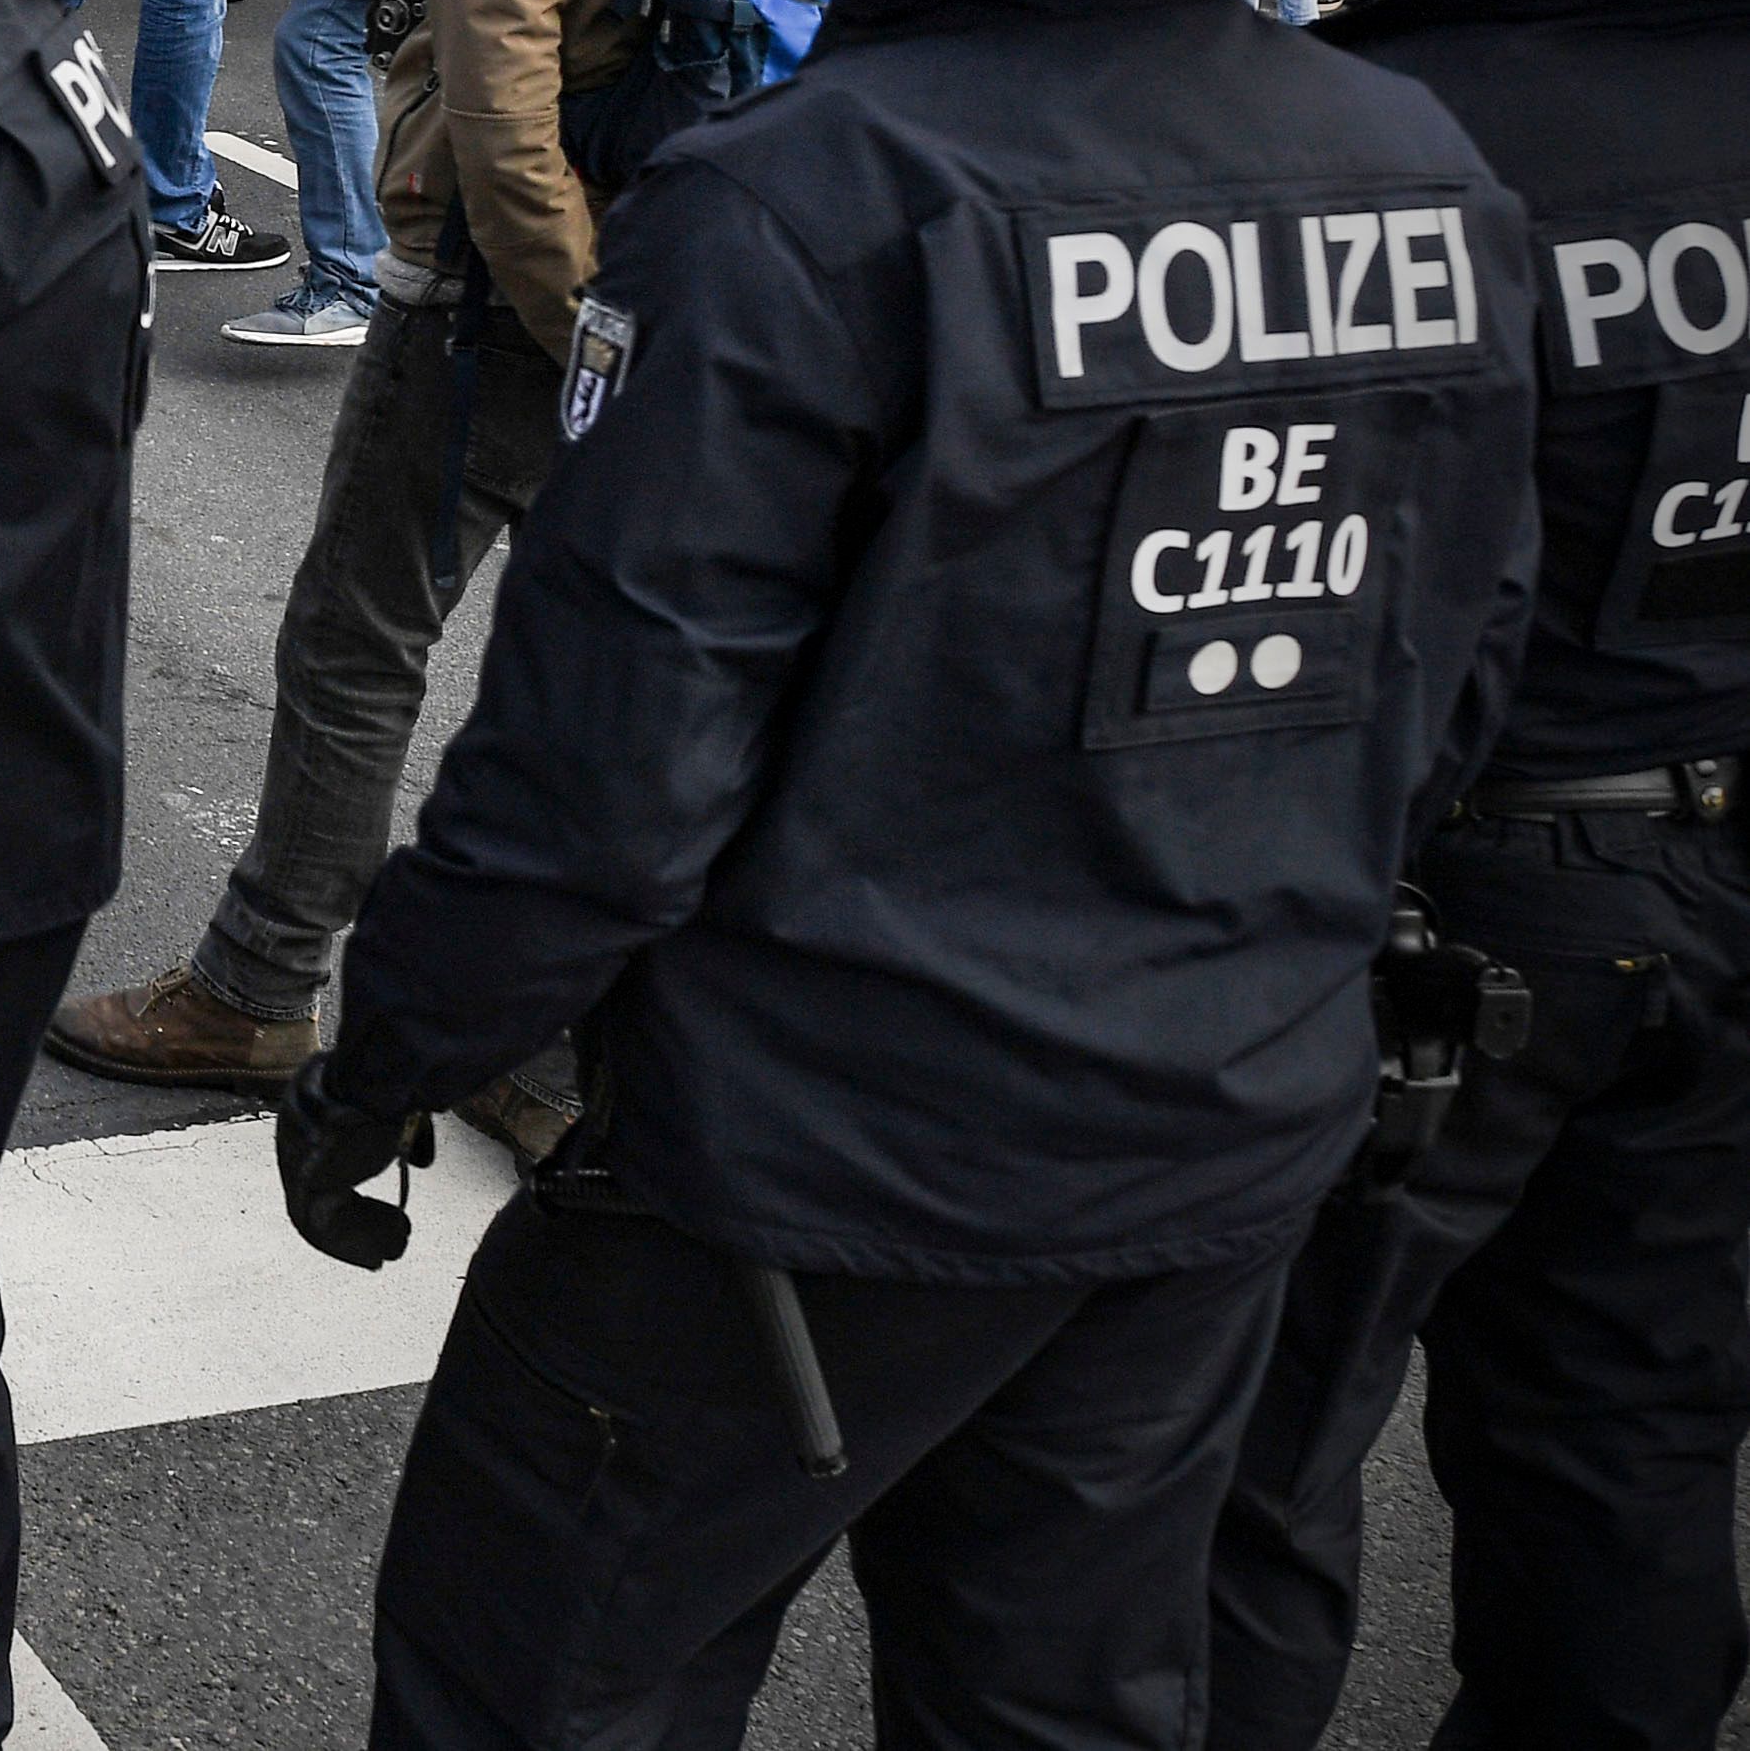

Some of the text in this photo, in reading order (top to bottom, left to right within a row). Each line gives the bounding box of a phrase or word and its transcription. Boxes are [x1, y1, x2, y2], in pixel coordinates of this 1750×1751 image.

[1047, 207, 1479, 378] POLIZEI
[1218, 423, 1337, 511] BE
[1131, 514, 1369, 614] C1110
